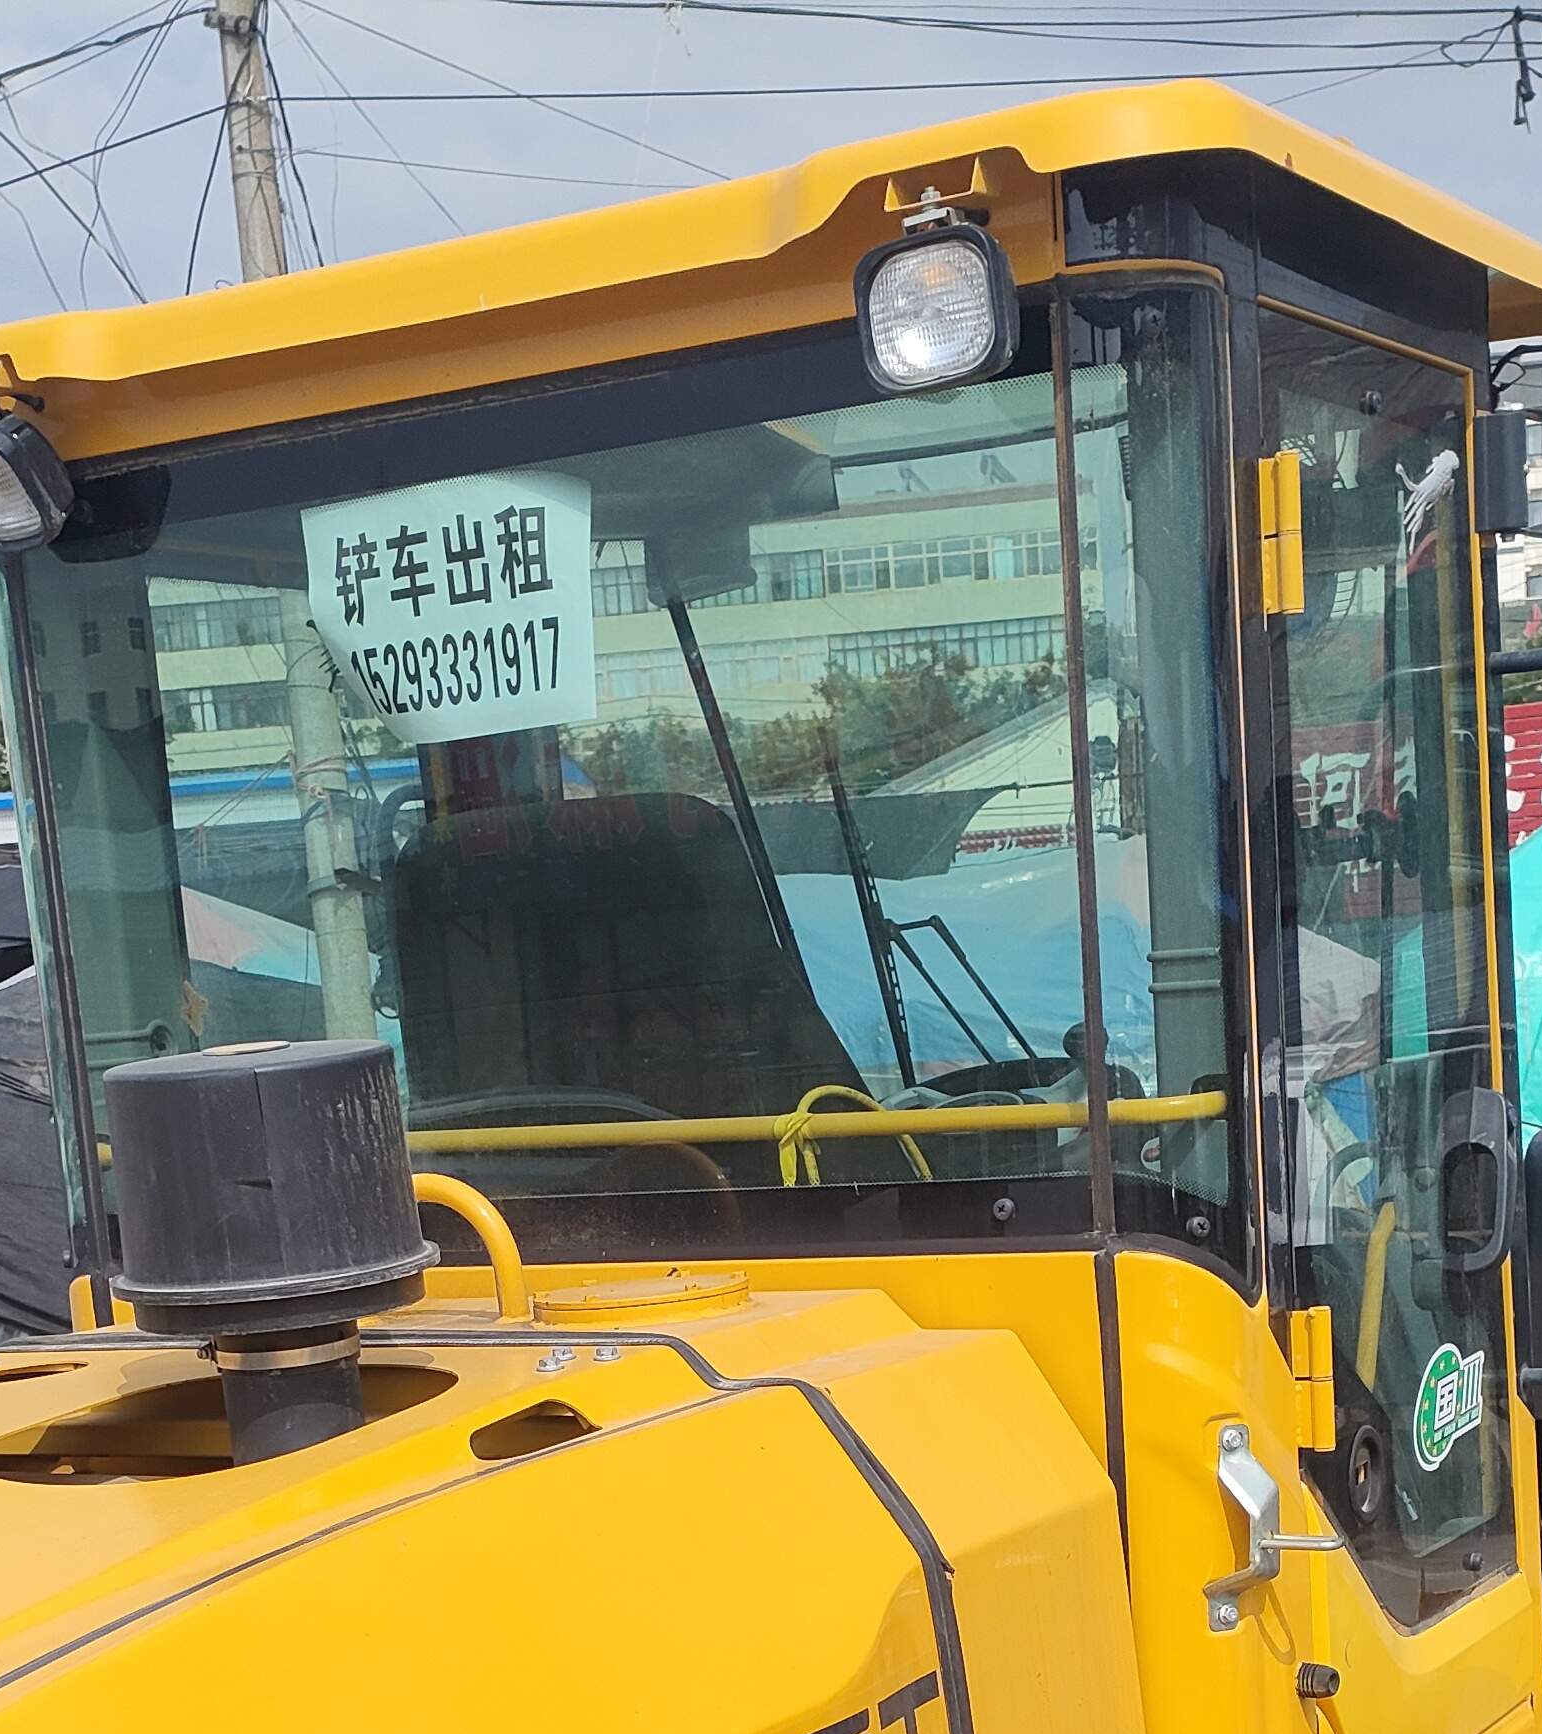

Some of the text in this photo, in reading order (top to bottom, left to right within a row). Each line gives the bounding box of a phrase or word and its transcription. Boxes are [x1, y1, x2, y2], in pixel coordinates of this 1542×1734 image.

[334, 505, 554, 626] 铲车出租
[351, 616, 560, 715] 15293331917
